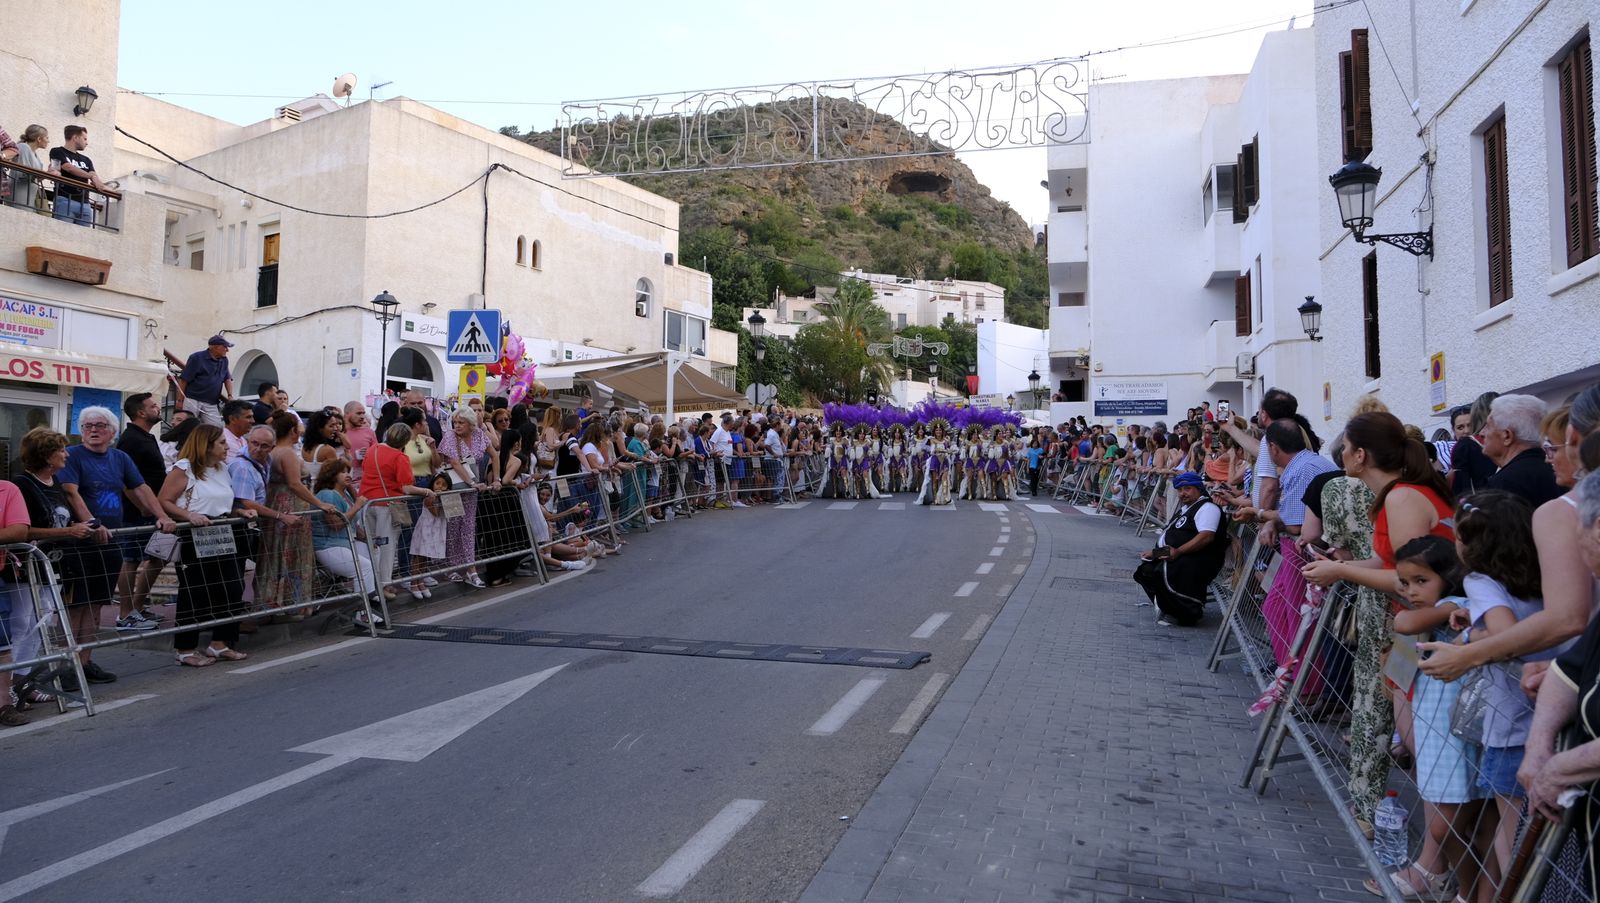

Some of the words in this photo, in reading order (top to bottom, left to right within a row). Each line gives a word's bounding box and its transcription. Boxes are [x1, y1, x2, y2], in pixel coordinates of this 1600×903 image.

[6, 323, 17, 332] DE
[18, 325, 45, 336] FUGAS
[52, 363, 91, 385] TITI
